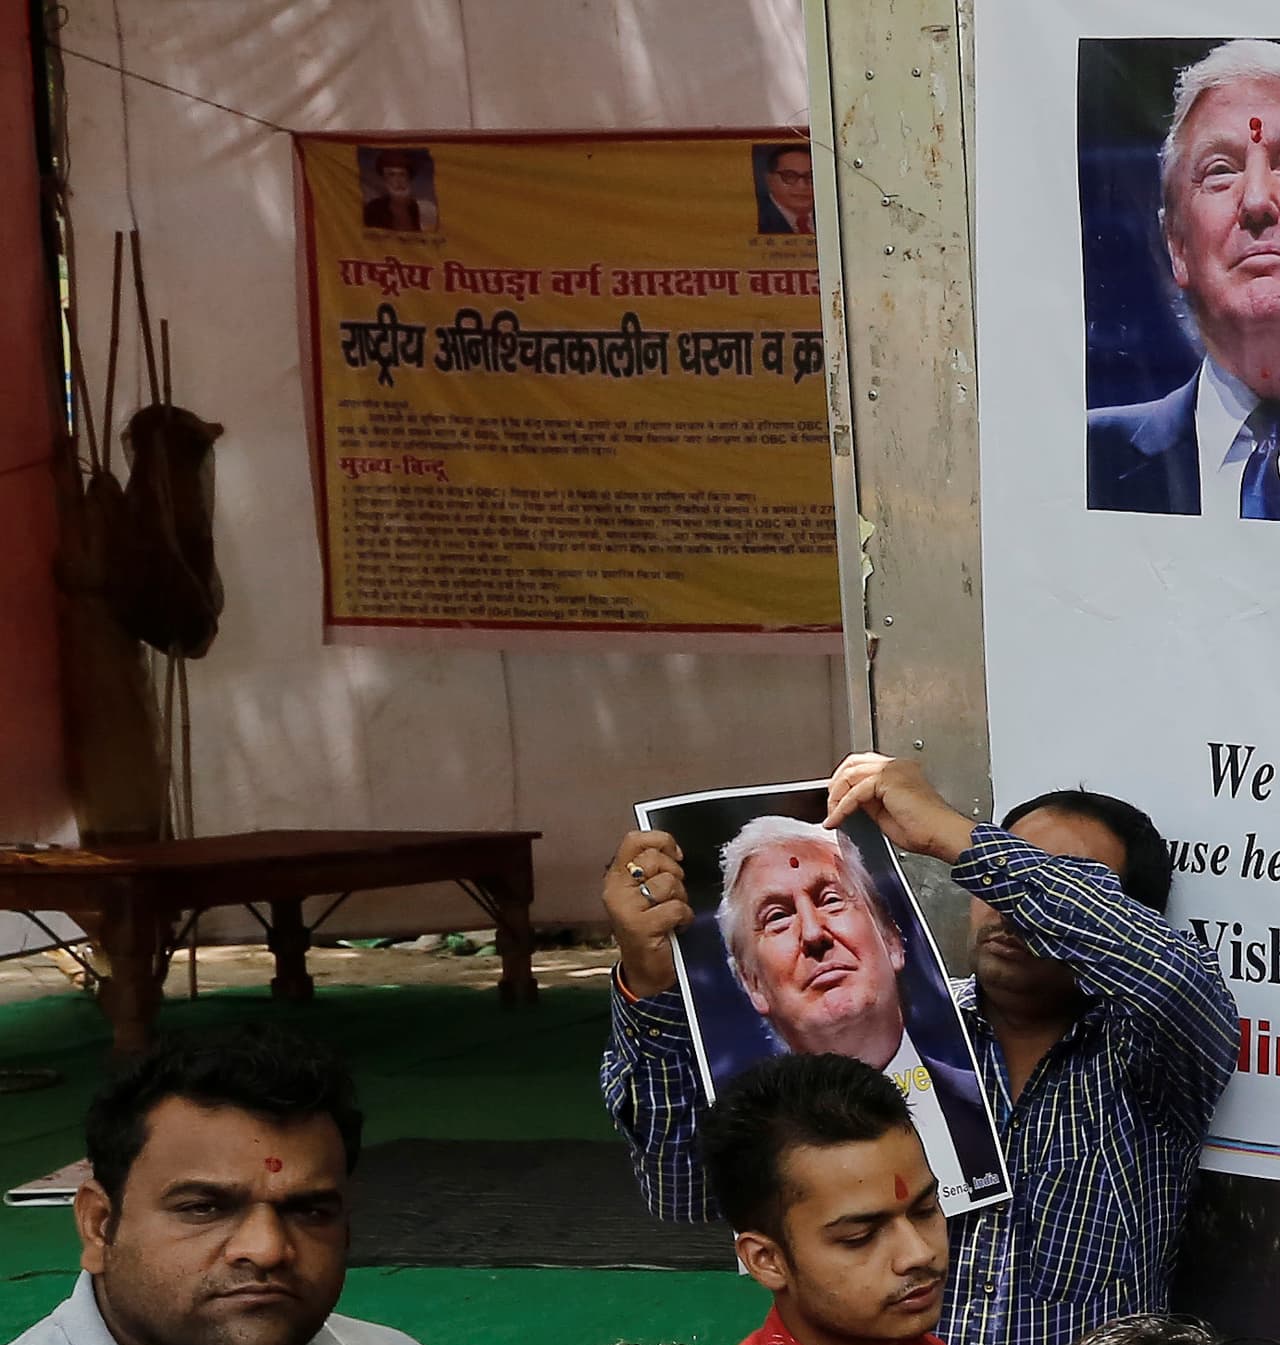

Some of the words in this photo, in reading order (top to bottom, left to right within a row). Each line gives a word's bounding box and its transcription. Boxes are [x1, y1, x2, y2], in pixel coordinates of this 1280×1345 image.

[338, 255, 434, 297] राष्ट्रीय
[552, 263, 602, 296] वर्ग
[612, 268, 740, 297] आरक्षण
[340, 302, 427, 388] राष्ट्रीय
[678, 331, 754, 377] धरना
[761, 331, 785, 375] व
[1207, 742, 1275, 801] We
[1161, 838, 1231, 876] use
